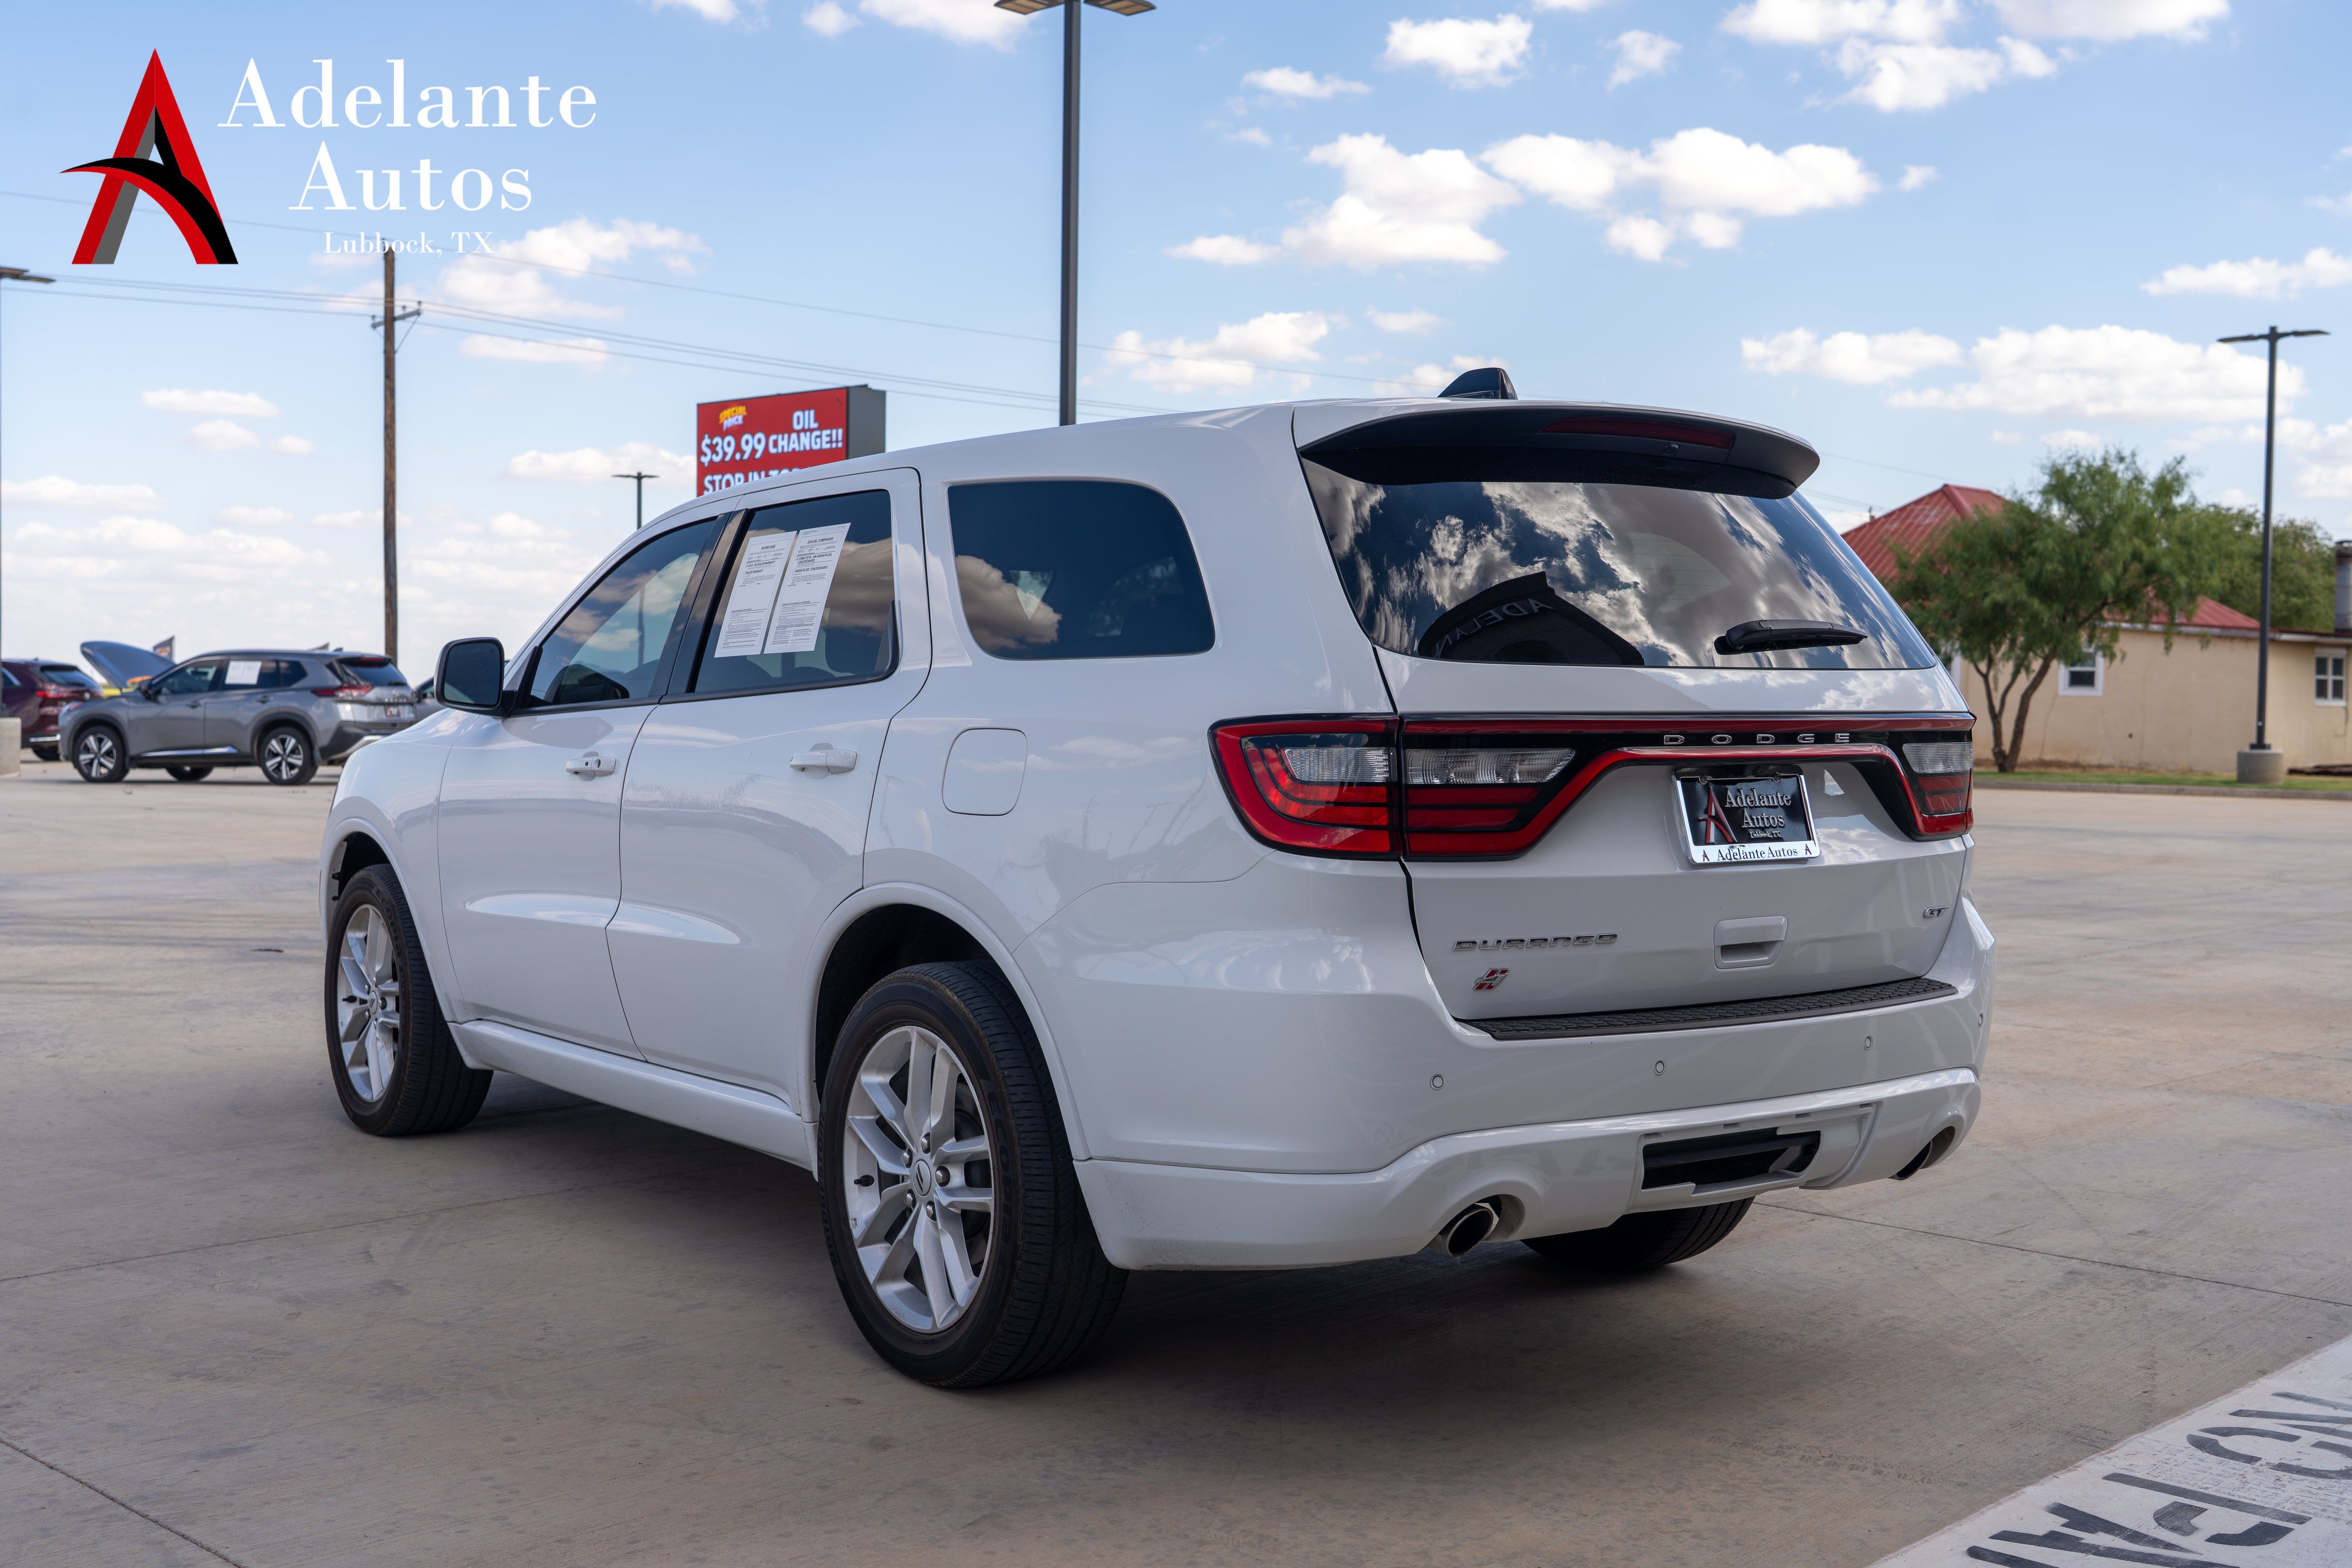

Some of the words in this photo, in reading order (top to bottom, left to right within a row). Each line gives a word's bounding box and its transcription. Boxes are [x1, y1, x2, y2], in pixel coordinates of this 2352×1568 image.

[793, 410, 818, 430] OIL
[700, 432, 766, 467] $39.99
[769, 428, 843, 454] CHANGE!!
[1664, 733, 1850, 745] DODGE
[1725, 789, 1791, 808] Adelante
[1742, 808, 1784, 828] Autos
[1717, 846, 1765, 861] Adelante
[1768, 843, 1798, 858] Autos
[1924, 906, 1949, 918] GT
[1452, 933, 1618, 951] DURANGO
